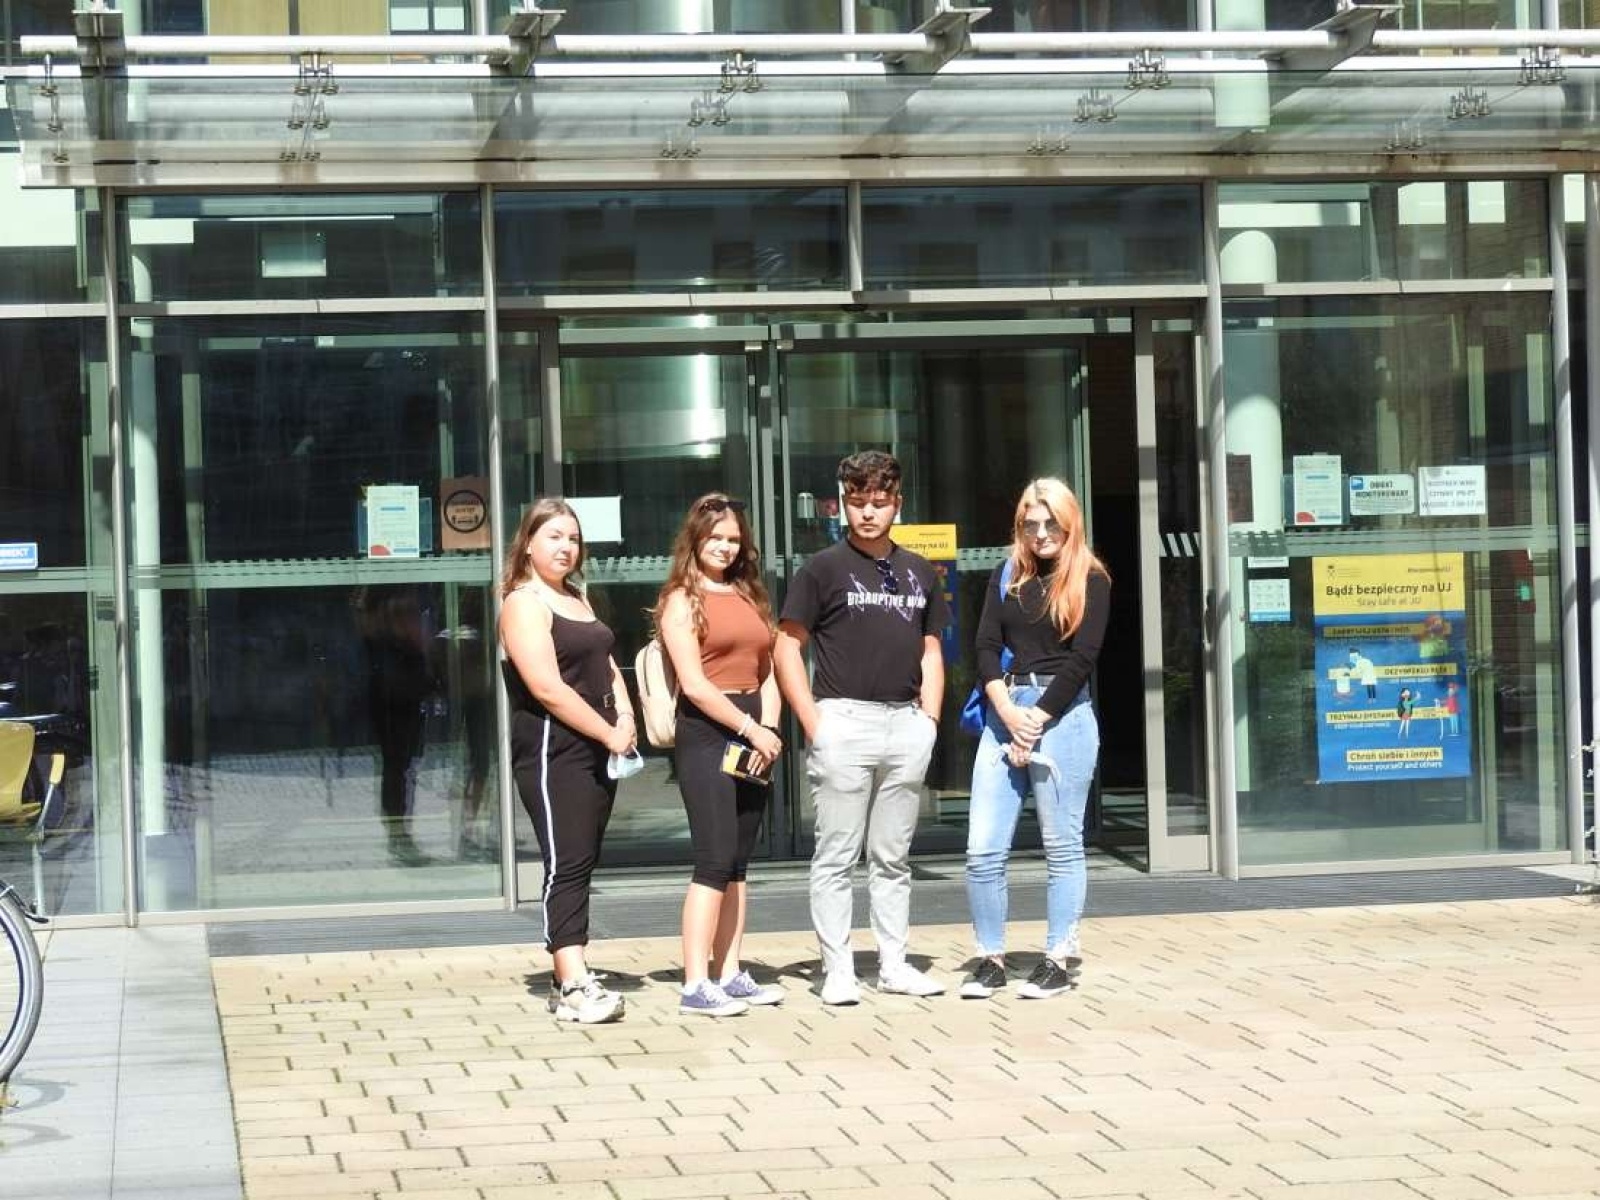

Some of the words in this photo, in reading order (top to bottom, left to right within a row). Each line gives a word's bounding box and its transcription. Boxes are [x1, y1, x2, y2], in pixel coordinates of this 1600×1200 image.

[1326, 584, 1354, 598] Bądź
[1356, 583, 1419, 597] bezpieczny
[1421, 584, 1435, 593] na
[1437, 581, 1452, 593] UJ
[847, 592, 904, 607] DISRUPTIVE
[1350, 751, 1374, 760] Chroń
[1376, 750, 1404, 760] siebie
[1410, 749, 1439, 760] innych
